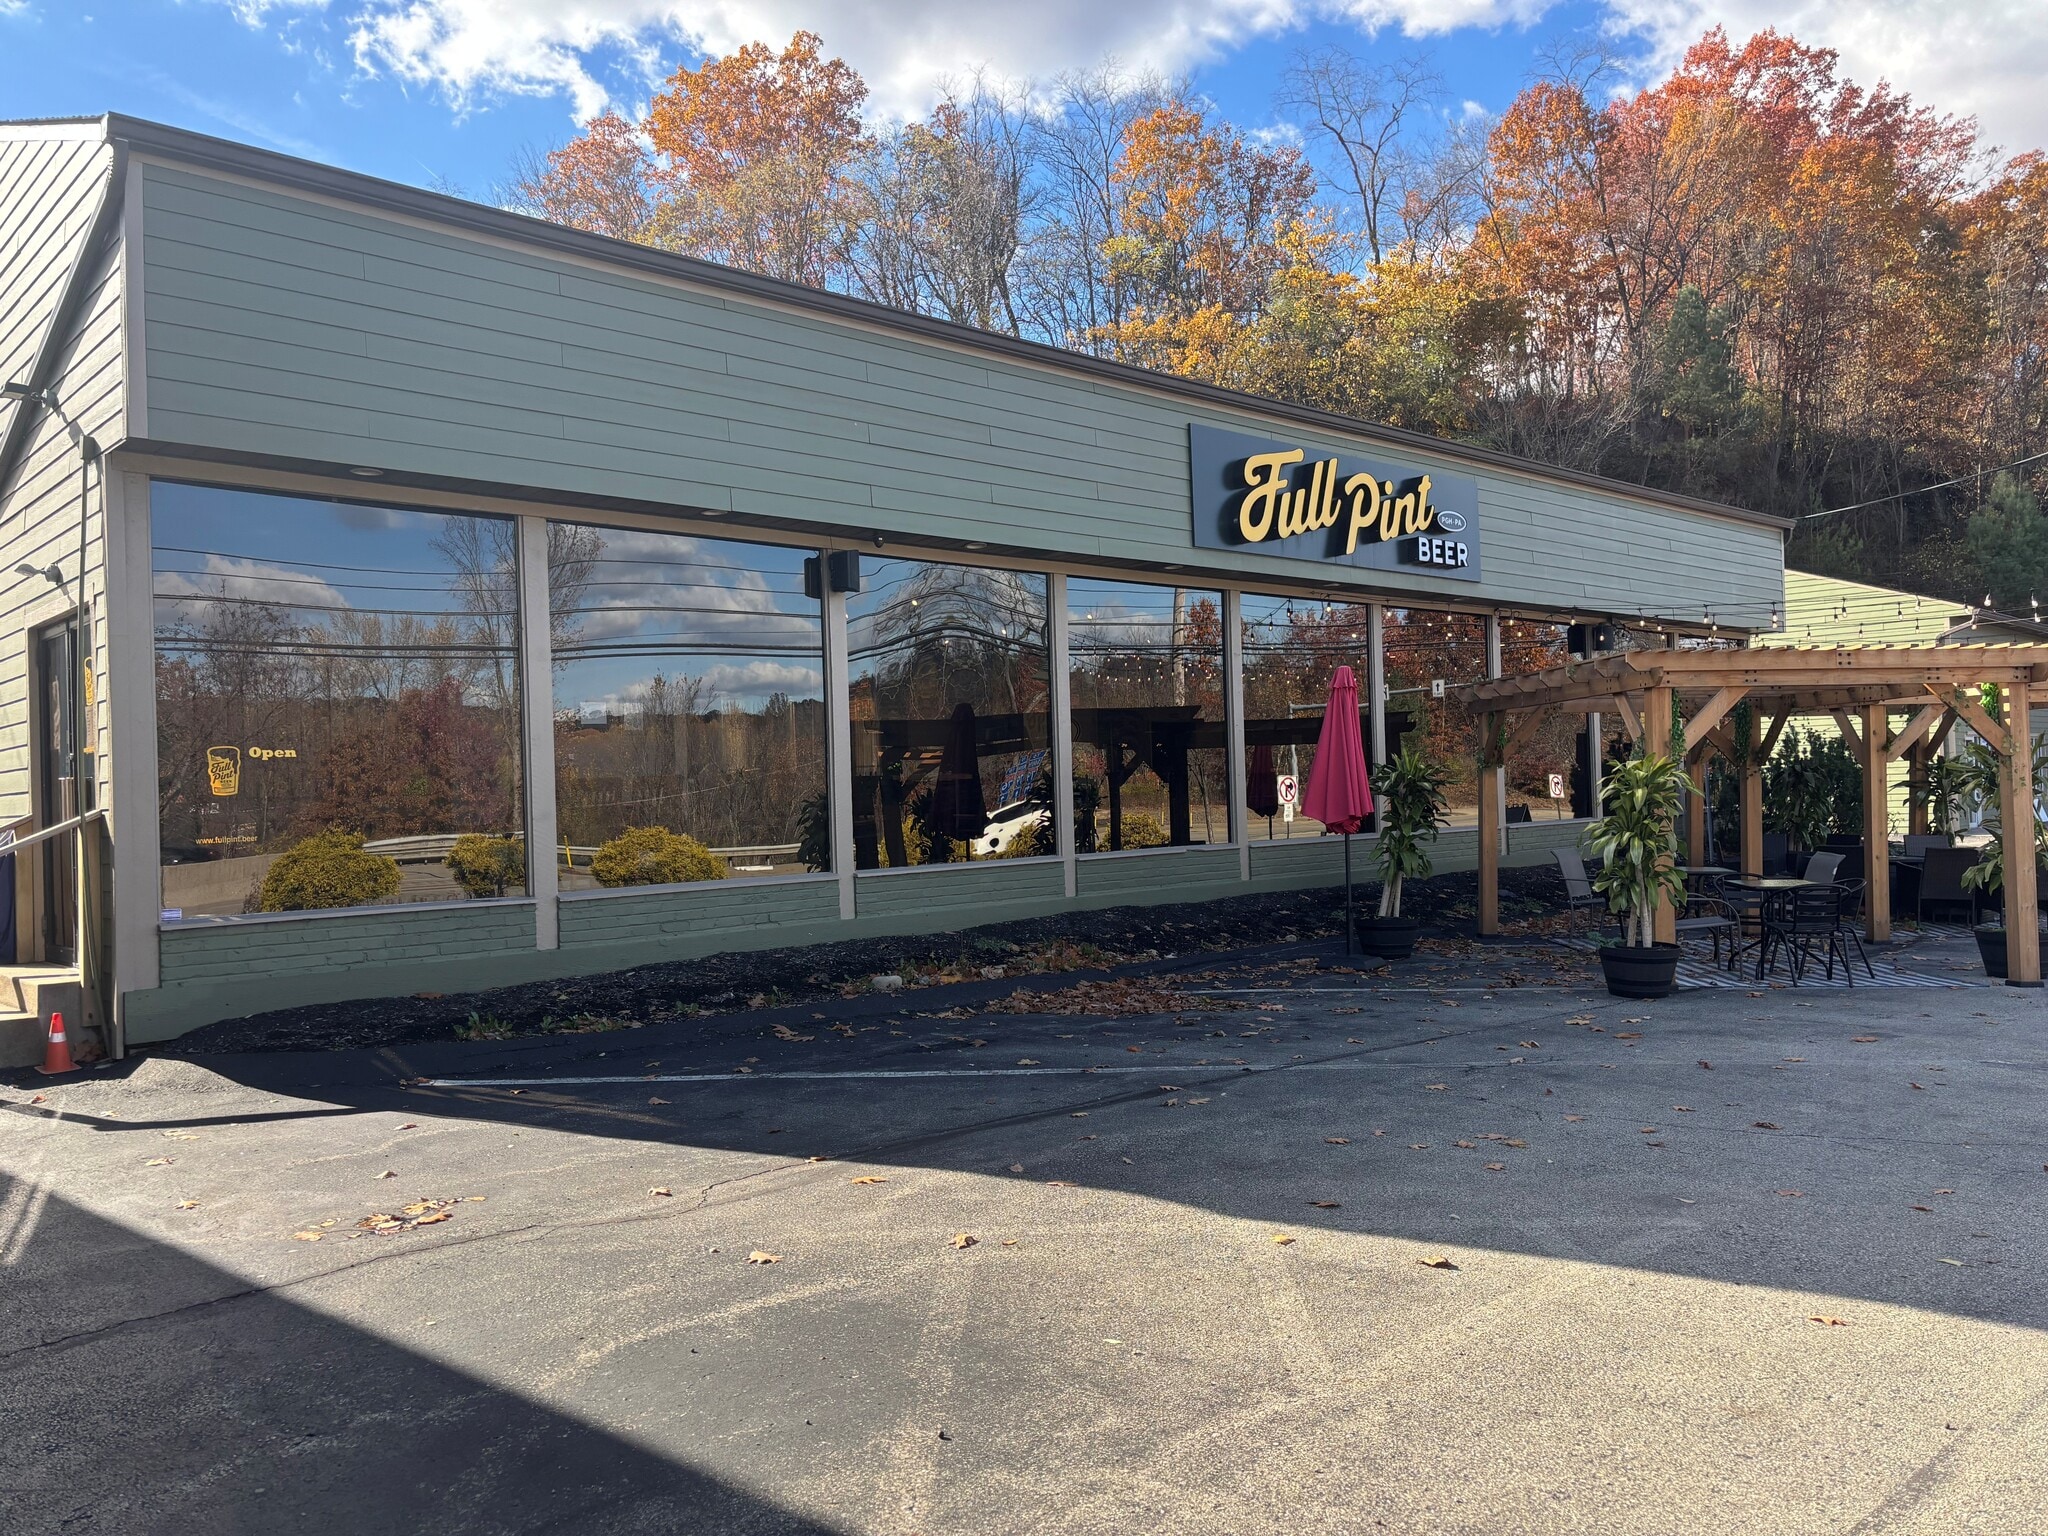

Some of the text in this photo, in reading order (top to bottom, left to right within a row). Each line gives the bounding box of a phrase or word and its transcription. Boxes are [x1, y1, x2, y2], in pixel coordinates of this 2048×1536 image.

[1239, 448, 1435, 555] Full Pint
[1418, 536, 1470, 567] BEER
[248, 746, 297, 761] Open
[211, 761, 232, 773] Full
[212, 770, 233, 784] Pint
[195, 836, 258, 844] www.fullpint.beer
